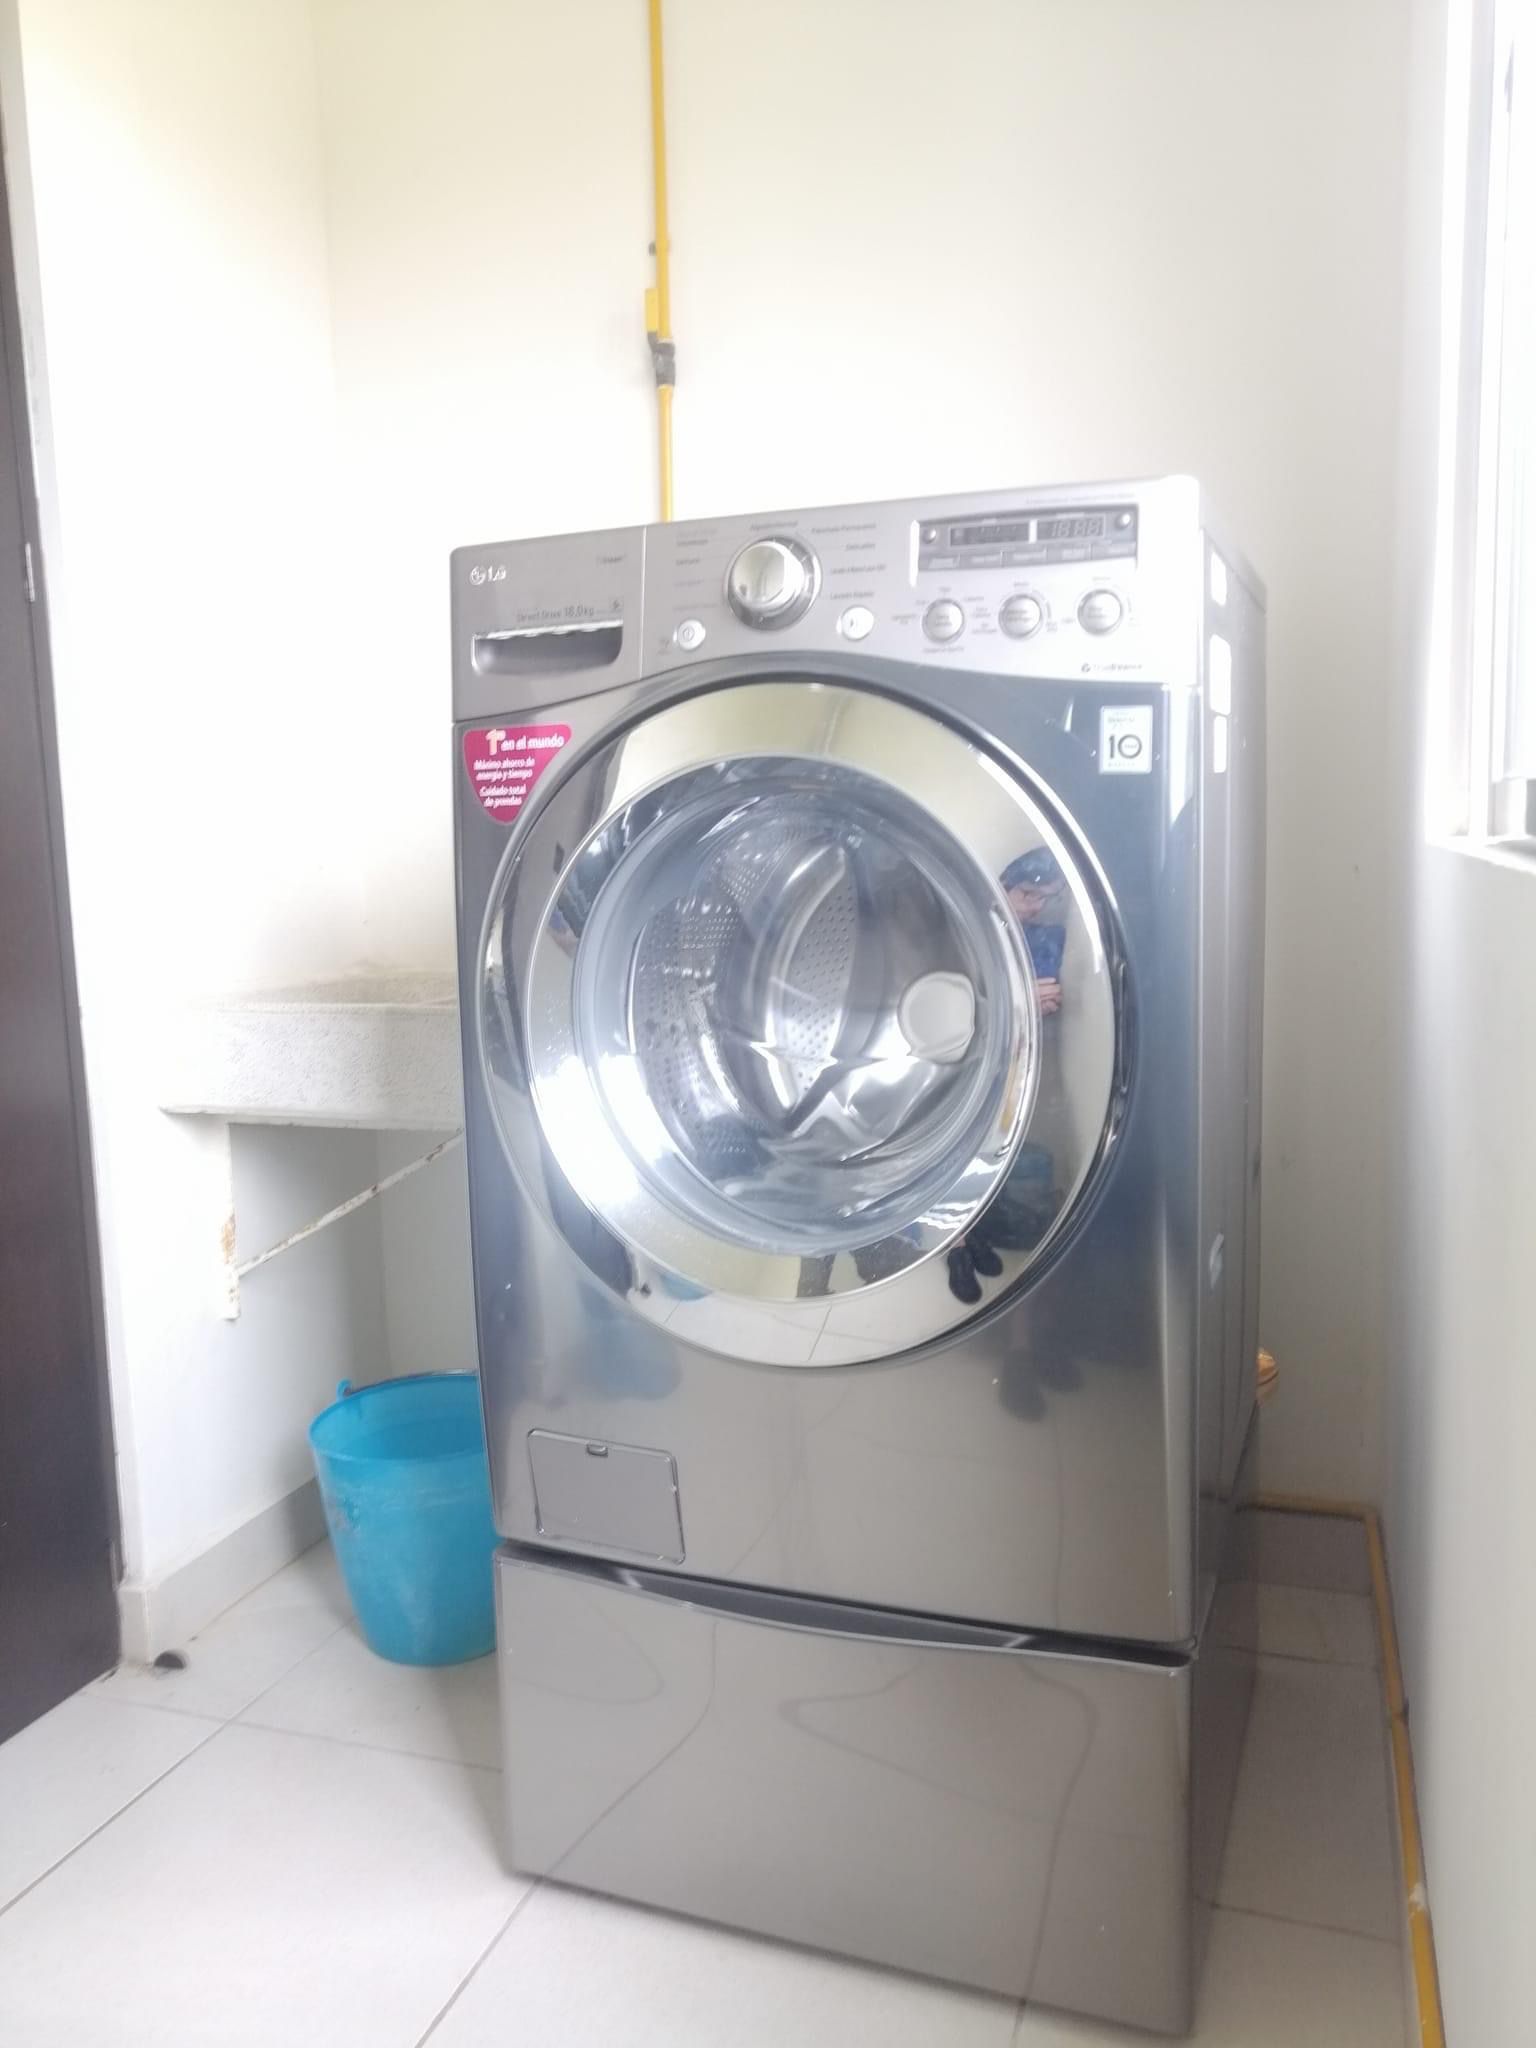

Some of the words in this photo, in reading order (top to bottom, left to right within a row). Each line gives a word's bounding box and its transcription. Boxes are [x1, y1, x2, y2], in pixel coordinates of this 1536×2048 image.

[501, 740, 515, 752] en
[516, 735, 527, 750] el
[527, 733, 565, 750] mundo
[1108, 734, 1143, 760] 10
[508, 784, 526, 795] total
